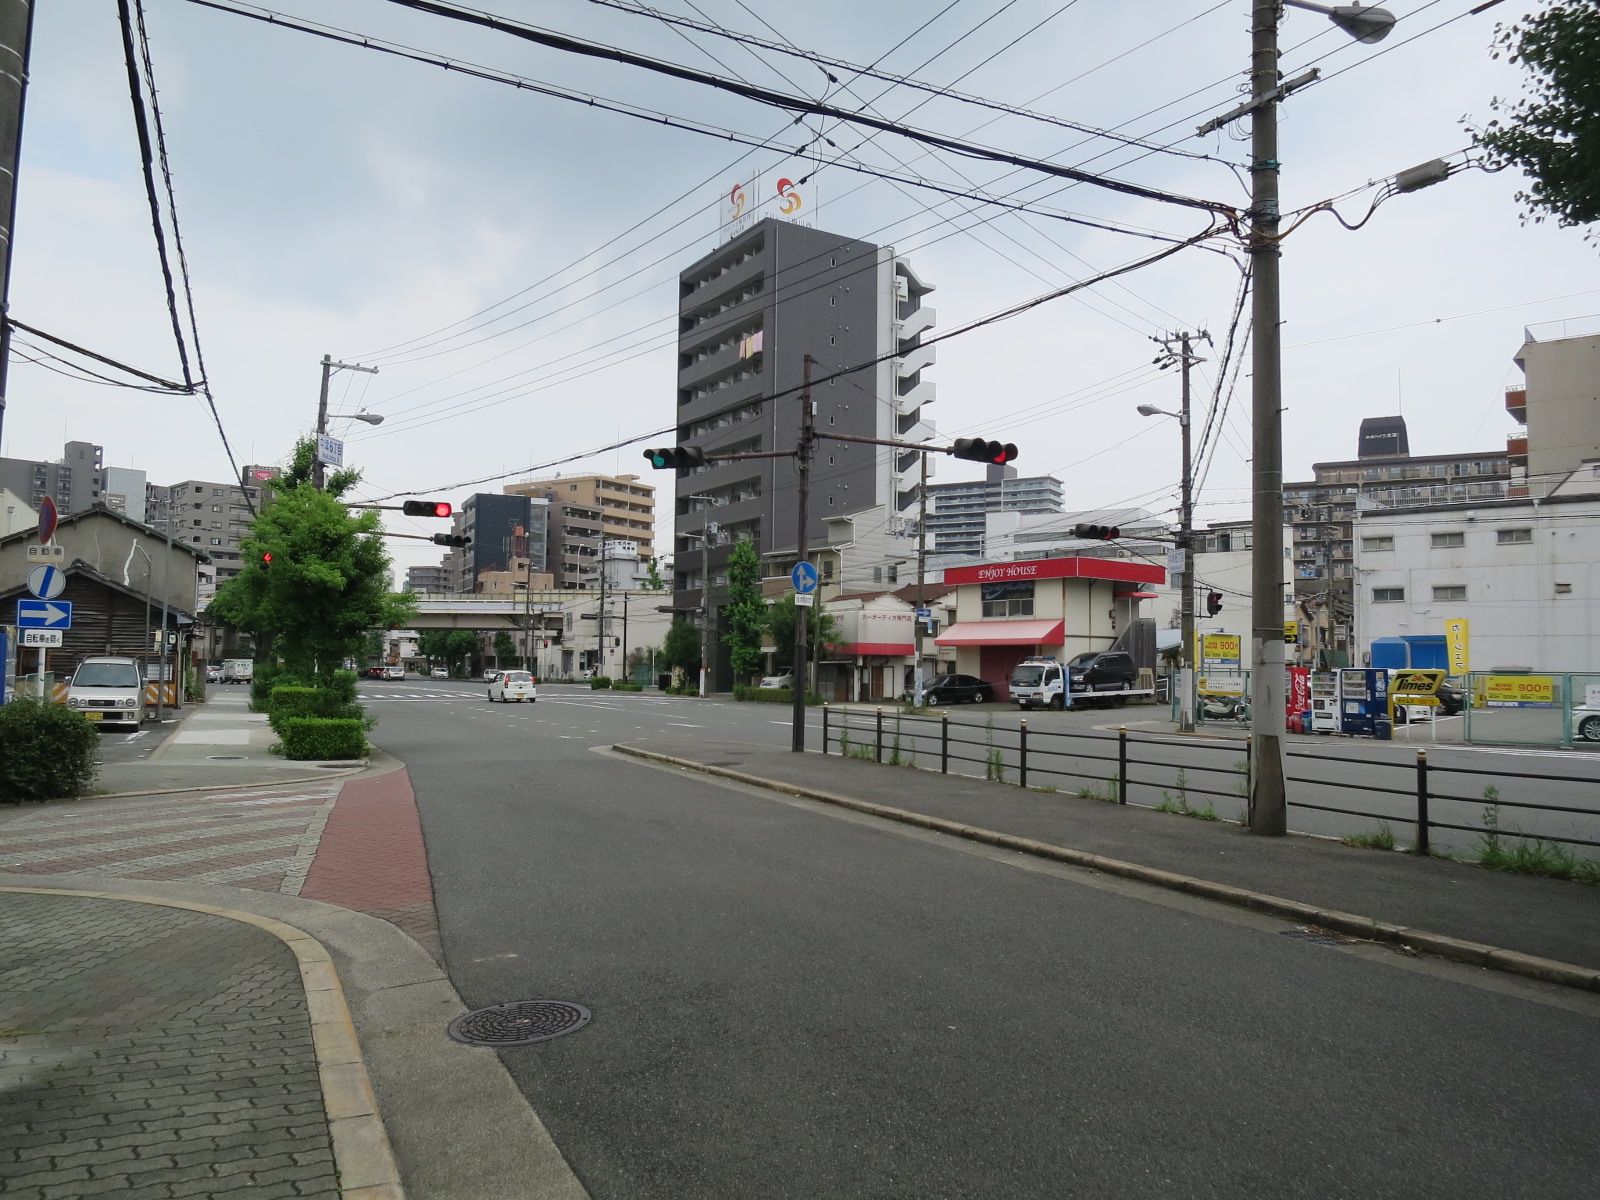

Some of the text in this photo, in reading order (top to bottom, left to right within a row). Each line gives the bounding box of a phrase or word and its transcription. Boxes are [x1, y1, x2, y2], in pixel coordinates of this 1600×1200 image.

[29, 547, 62, 555] 自動車
[978, 564, 1037, 580] ENJOY HOUSE
[1397, 678, 1434, 691] Times
